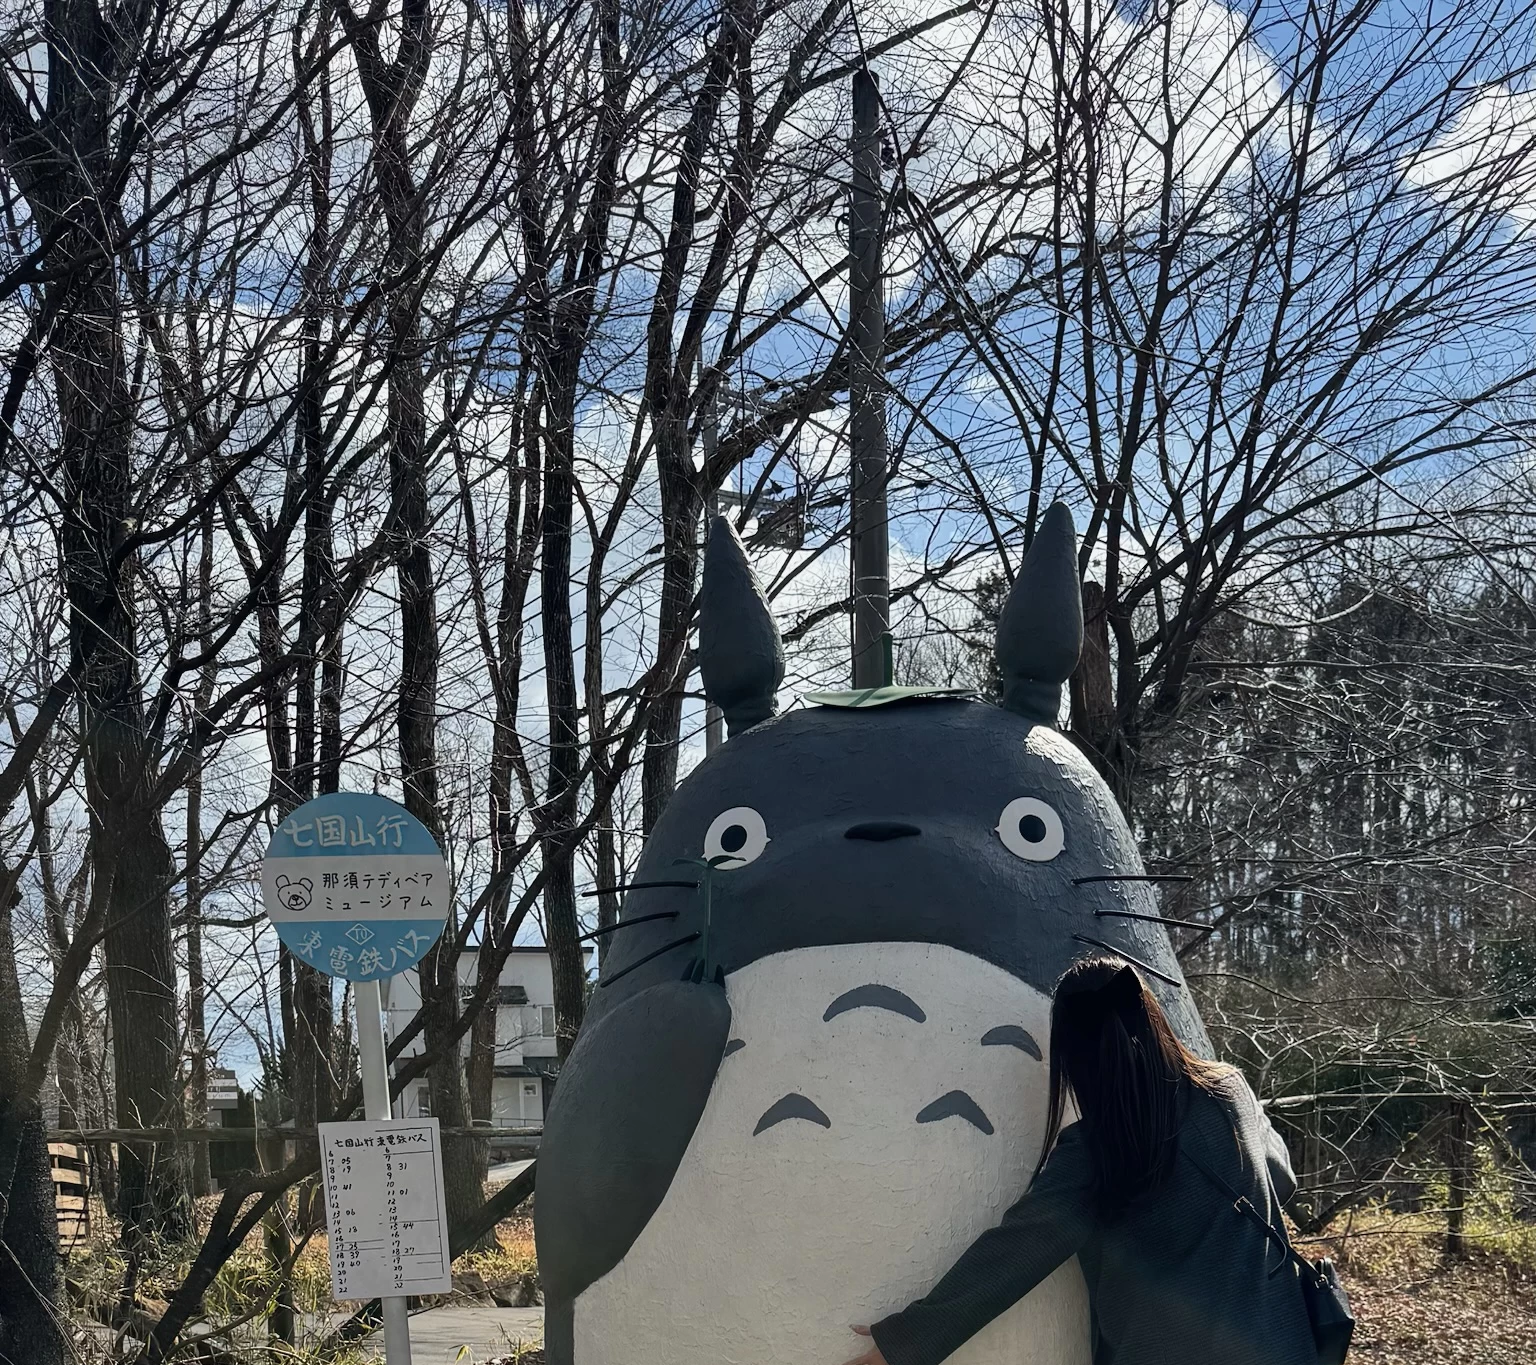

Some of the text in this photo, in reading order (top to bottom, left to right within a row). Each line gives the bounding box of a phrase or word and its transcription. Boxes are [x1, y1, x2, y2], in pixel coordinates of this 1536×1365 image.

[284, 814, 408, 848] 七国山行
[322, 872, 433, 889] 那須テディベア
[325, 894, 433, 910] ミュージアム
[341, 1157, 351, 1165] 05
[400, 1188, 408, 1196] 01
[389, 1206, 397, 1214] 13
[333, 1211, 341, 1219] 13
[390, 1222, 414, 1231] 15 44
[336, 1243, 344, 1251] 17
[392, 1247, 415, 1256] 18 27
